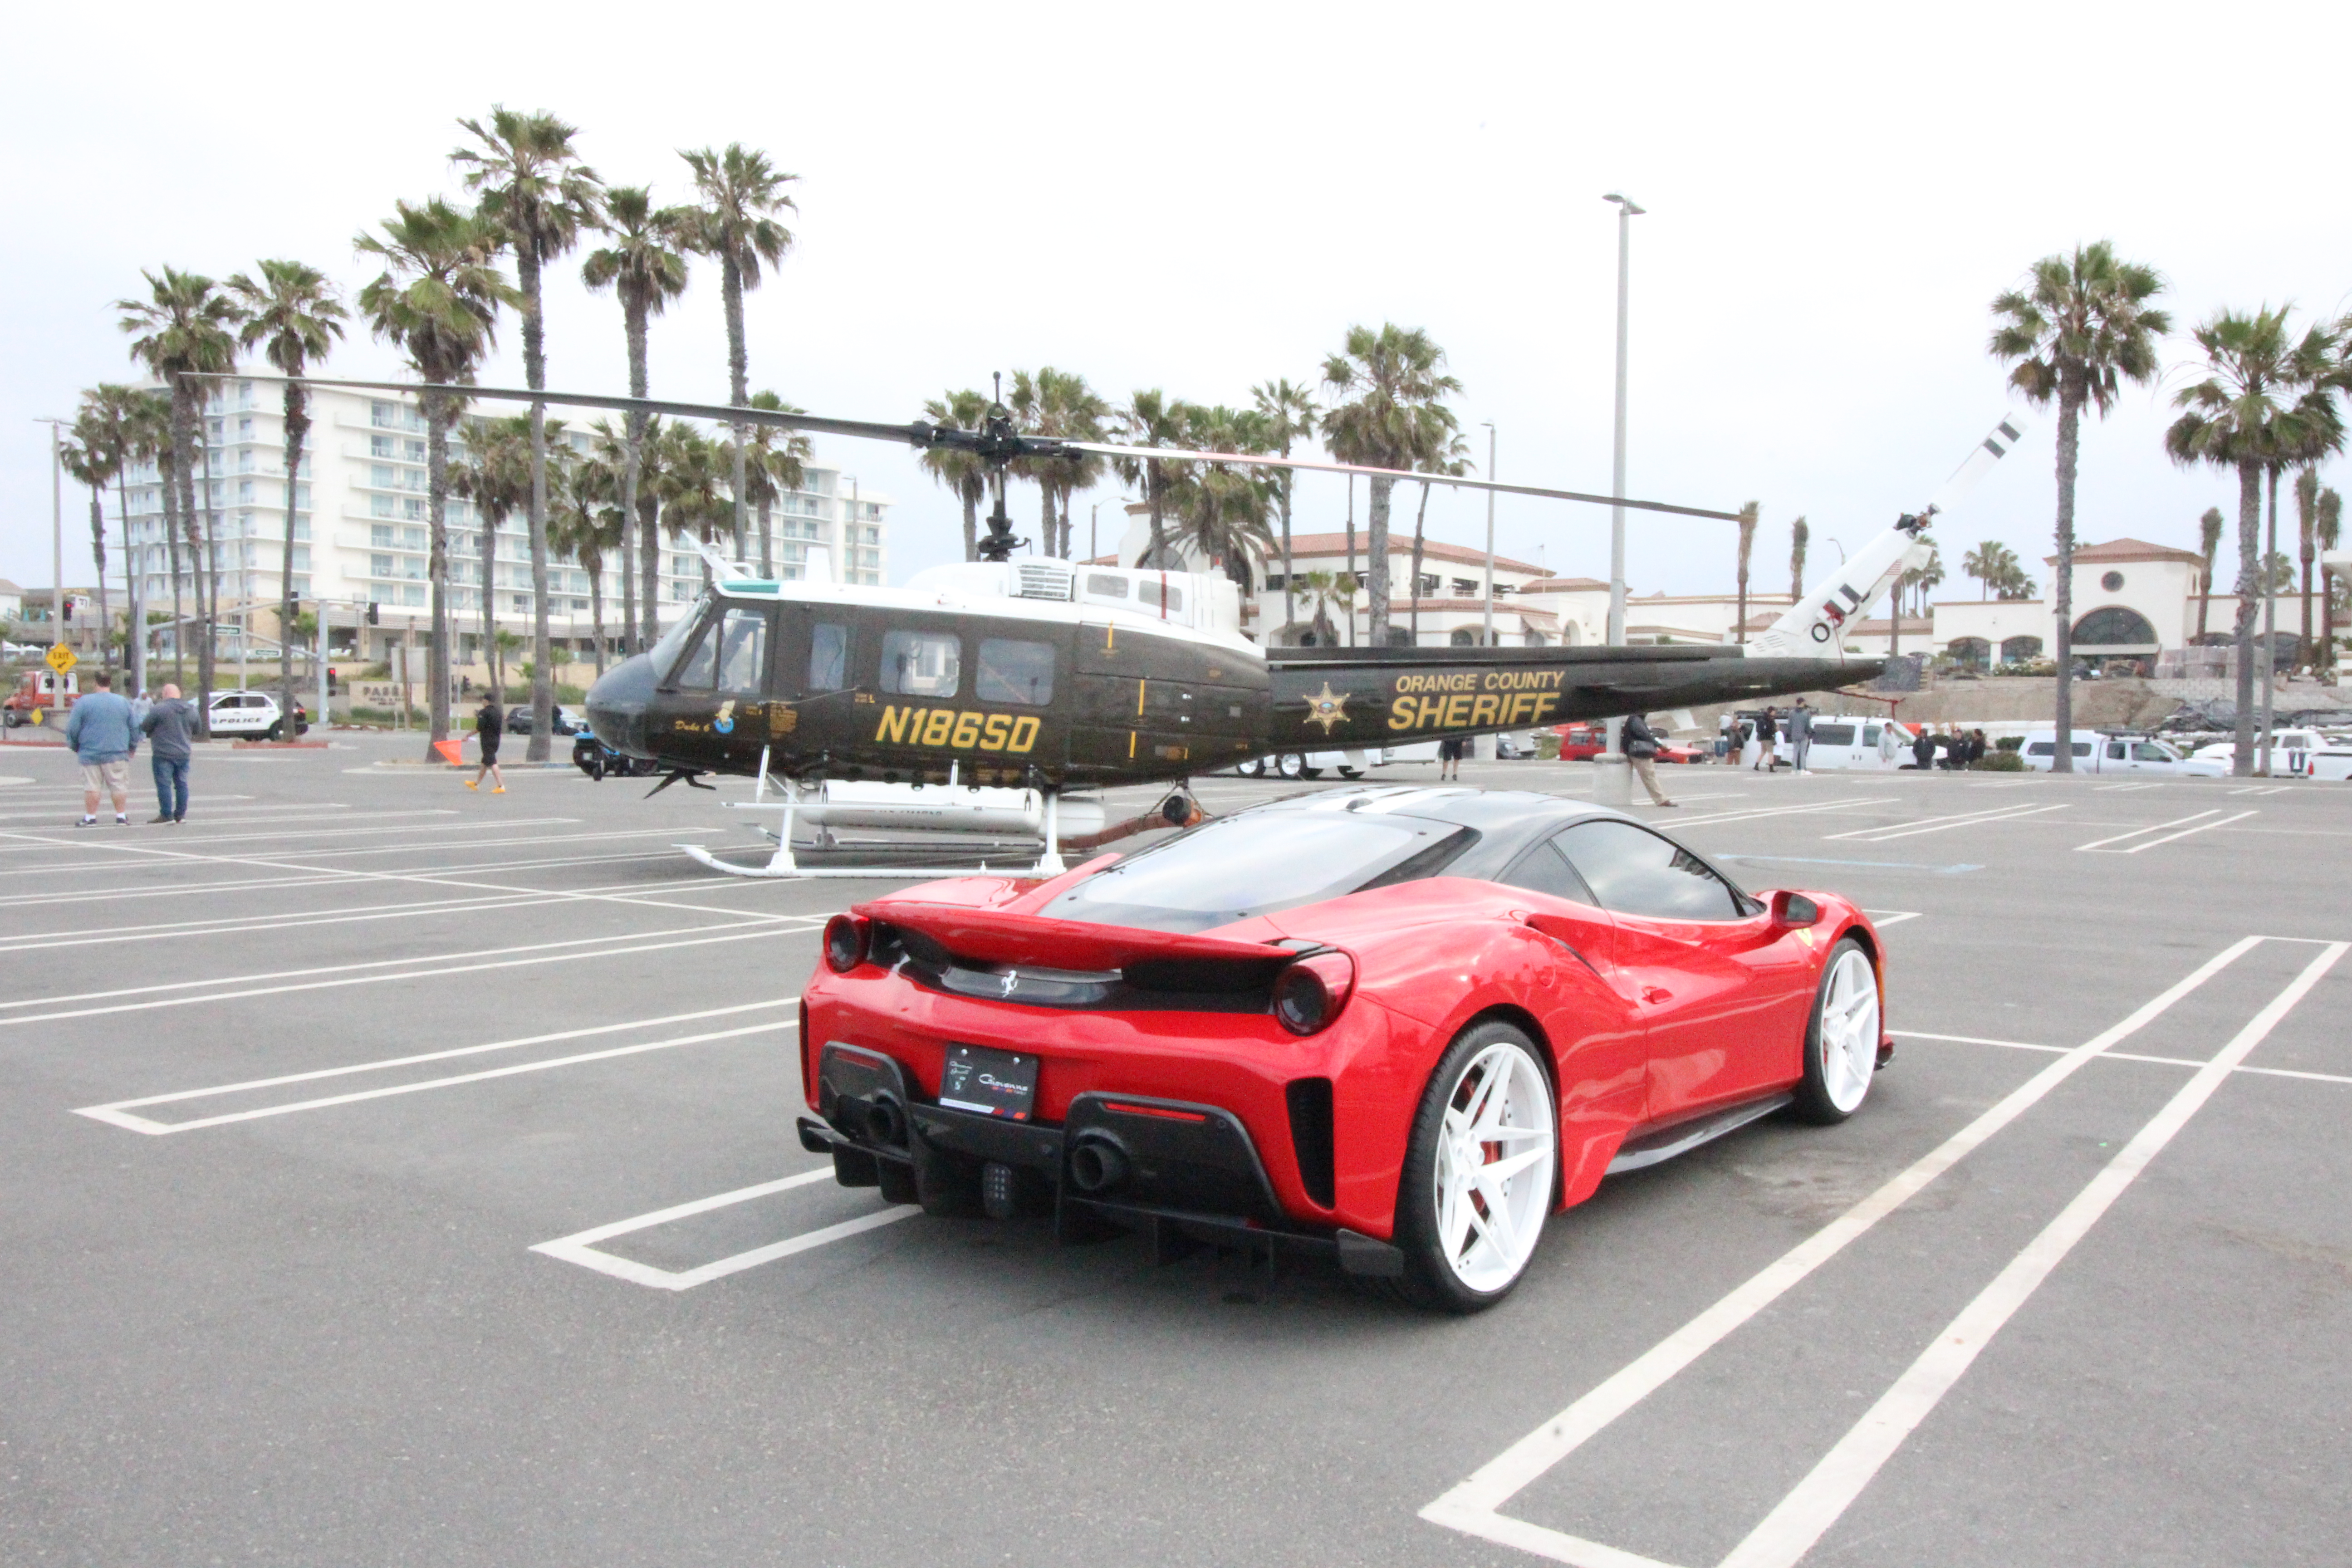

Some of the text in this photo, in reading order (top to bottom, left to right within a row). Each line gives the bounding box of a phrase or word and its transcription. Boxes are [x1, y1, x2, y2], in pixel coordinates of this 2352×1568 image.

[1396, 671, 1565, 693] ORANGE COUNTY
[875, 705, 1041, 753] N186SD
[1387, 692, 1561, 730] SHERIFF
